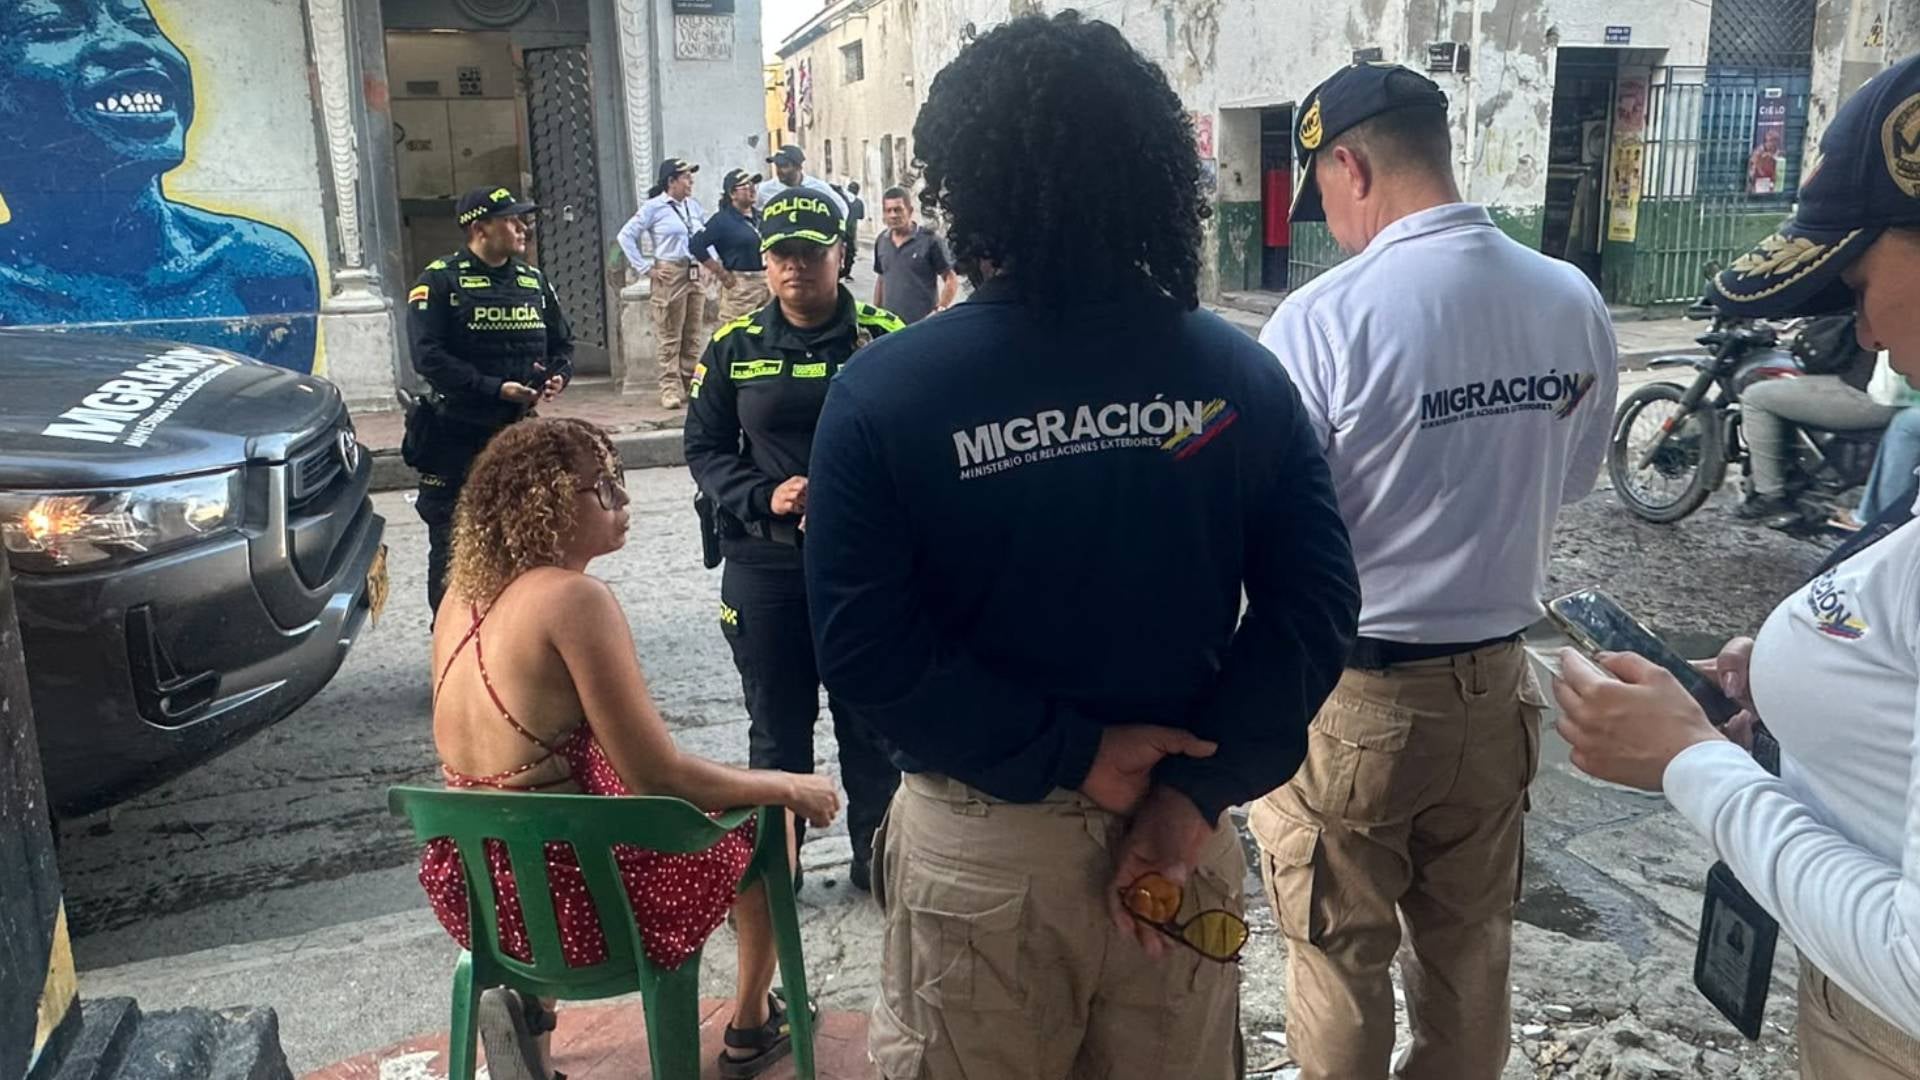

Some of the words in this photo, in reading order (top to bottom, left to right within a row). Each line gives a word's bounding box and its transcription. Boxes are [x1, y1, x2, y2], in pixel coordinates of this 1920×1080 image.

[474, 303, 541, 322] POLICÍA
[40, 346, 218, 444] MIGRACIÓN
[1420, 369, 1579, 420] MIGRACIÓN
[952, 393, 1203, 468] MIGRACIÓN
[959, 456, 1023, 480] MINISTERIO
[1025, 450, 1038, 464] DE
[1039, 442, 1099, 460] RELACIONES
[1100, 436, 1163, 452] EXTERIORES
